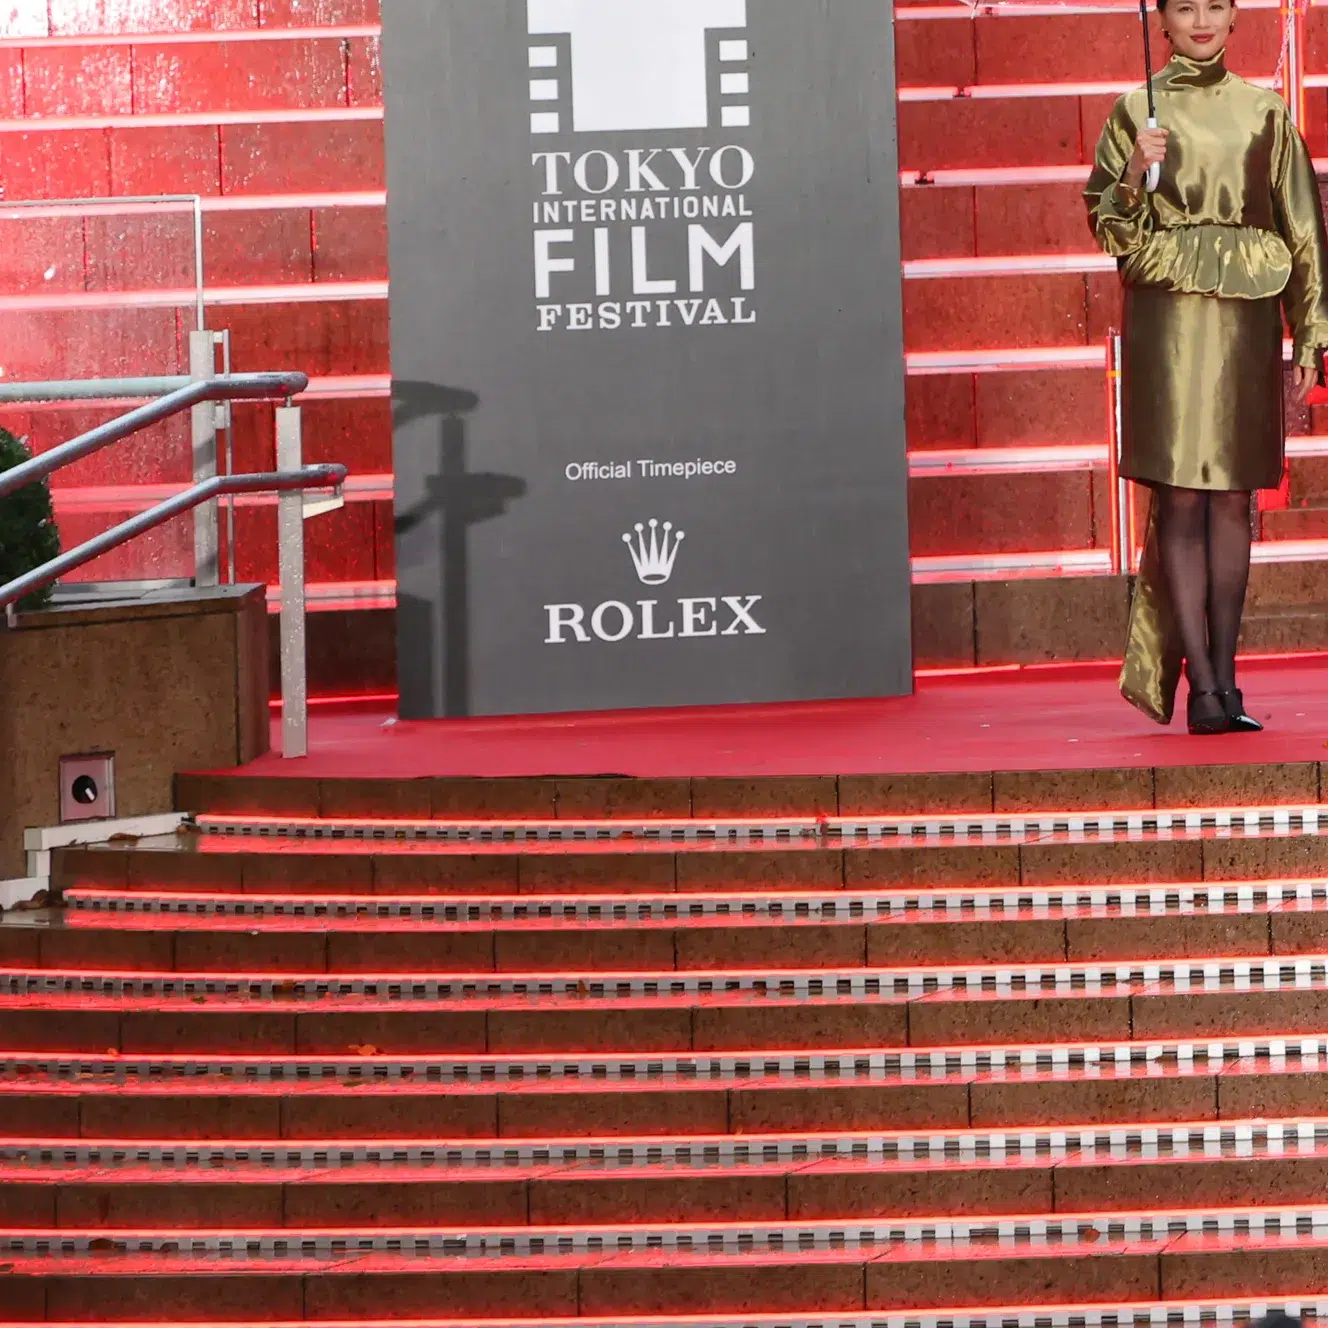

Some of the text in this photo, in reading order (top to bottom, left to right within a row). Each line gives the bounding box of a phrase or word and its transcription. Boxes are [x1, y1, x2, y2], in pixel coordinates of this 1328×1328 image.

[531, 144, 755, 195] TOKYO
[532, 193, 753, 224] INTERNATIONAL
[533, 221, 755, 299] FILM
[536, 297, 756, 331] FESTIVAL
[564, 457, 737, 481] Official Timepiece
[543, 595, 767, 644] ROLEX
